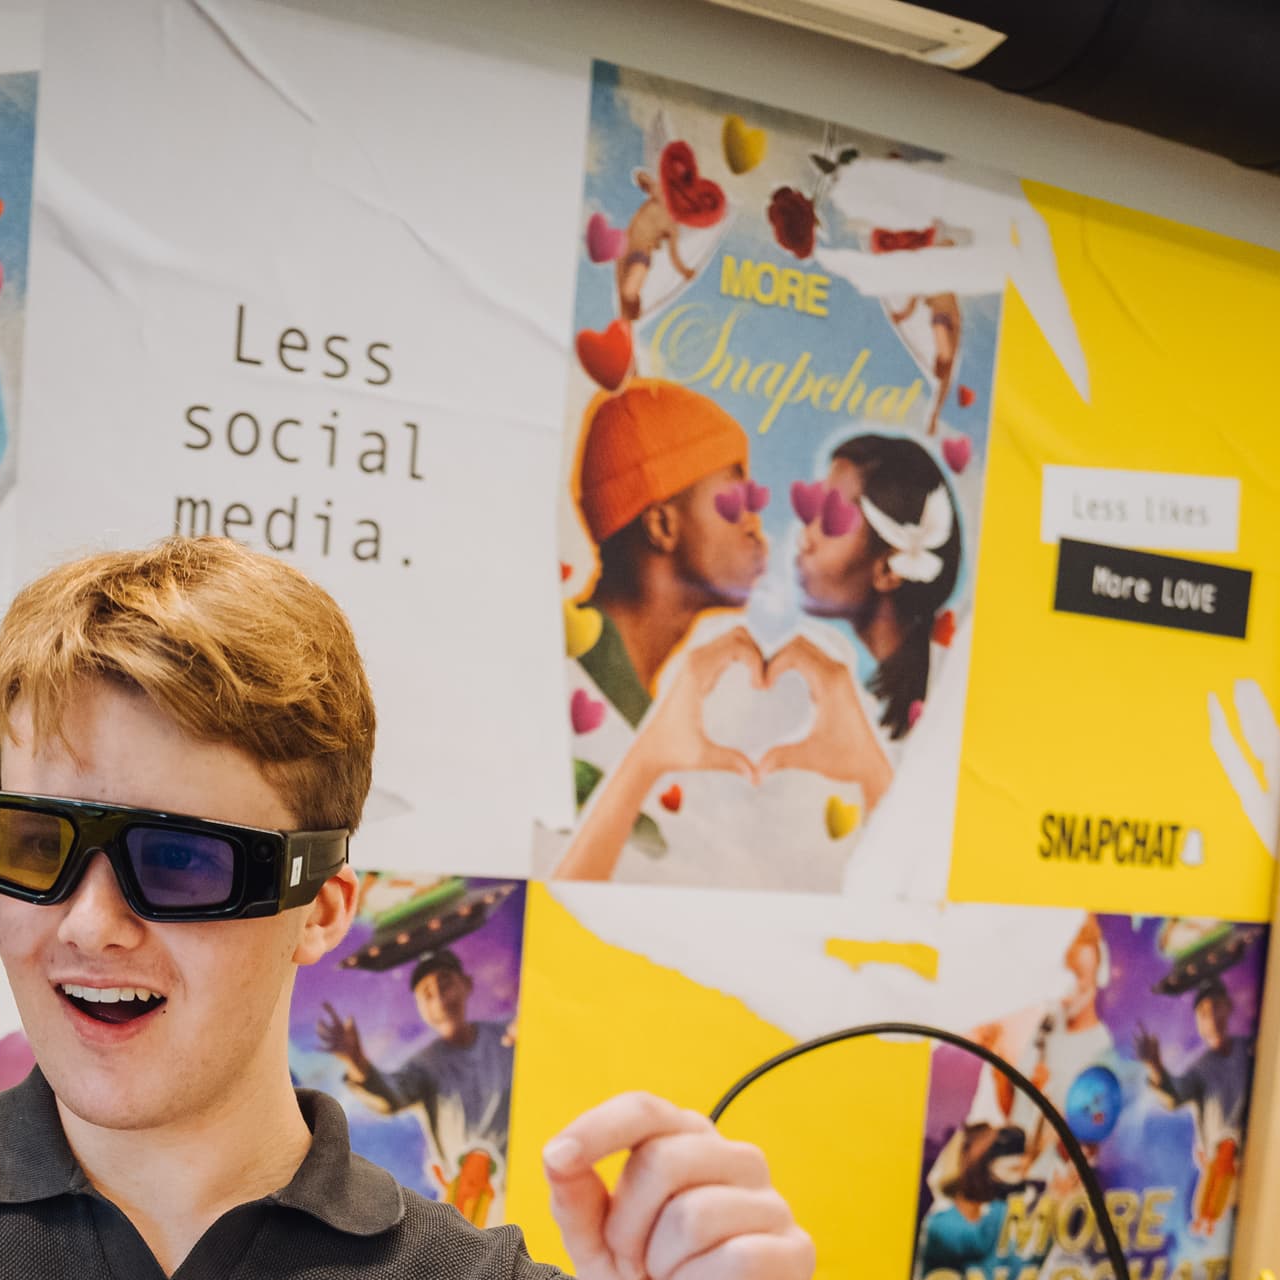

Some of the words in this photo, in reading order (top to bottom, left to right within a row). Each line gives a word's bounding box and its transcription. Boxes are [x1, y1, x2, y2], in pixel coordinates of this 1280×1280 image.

[720, 255, 831, 317] MORE
[233, 303, 395, 387] Less
[650, 300, 928, 435] Snapchat
[182, 403, 426, 481] social
[173, 495, 413, 568] media.
[1071, 494, 1129, 523] Less
[1144, 495, 1210, 528] likes
[1091, 566, 1151, 603] More
[1161, 577, 1218, 614] LOVE
[1038, 813, 1181, 868] SNAPCHAT
[998, 1189, 1175, 1255] MORE
